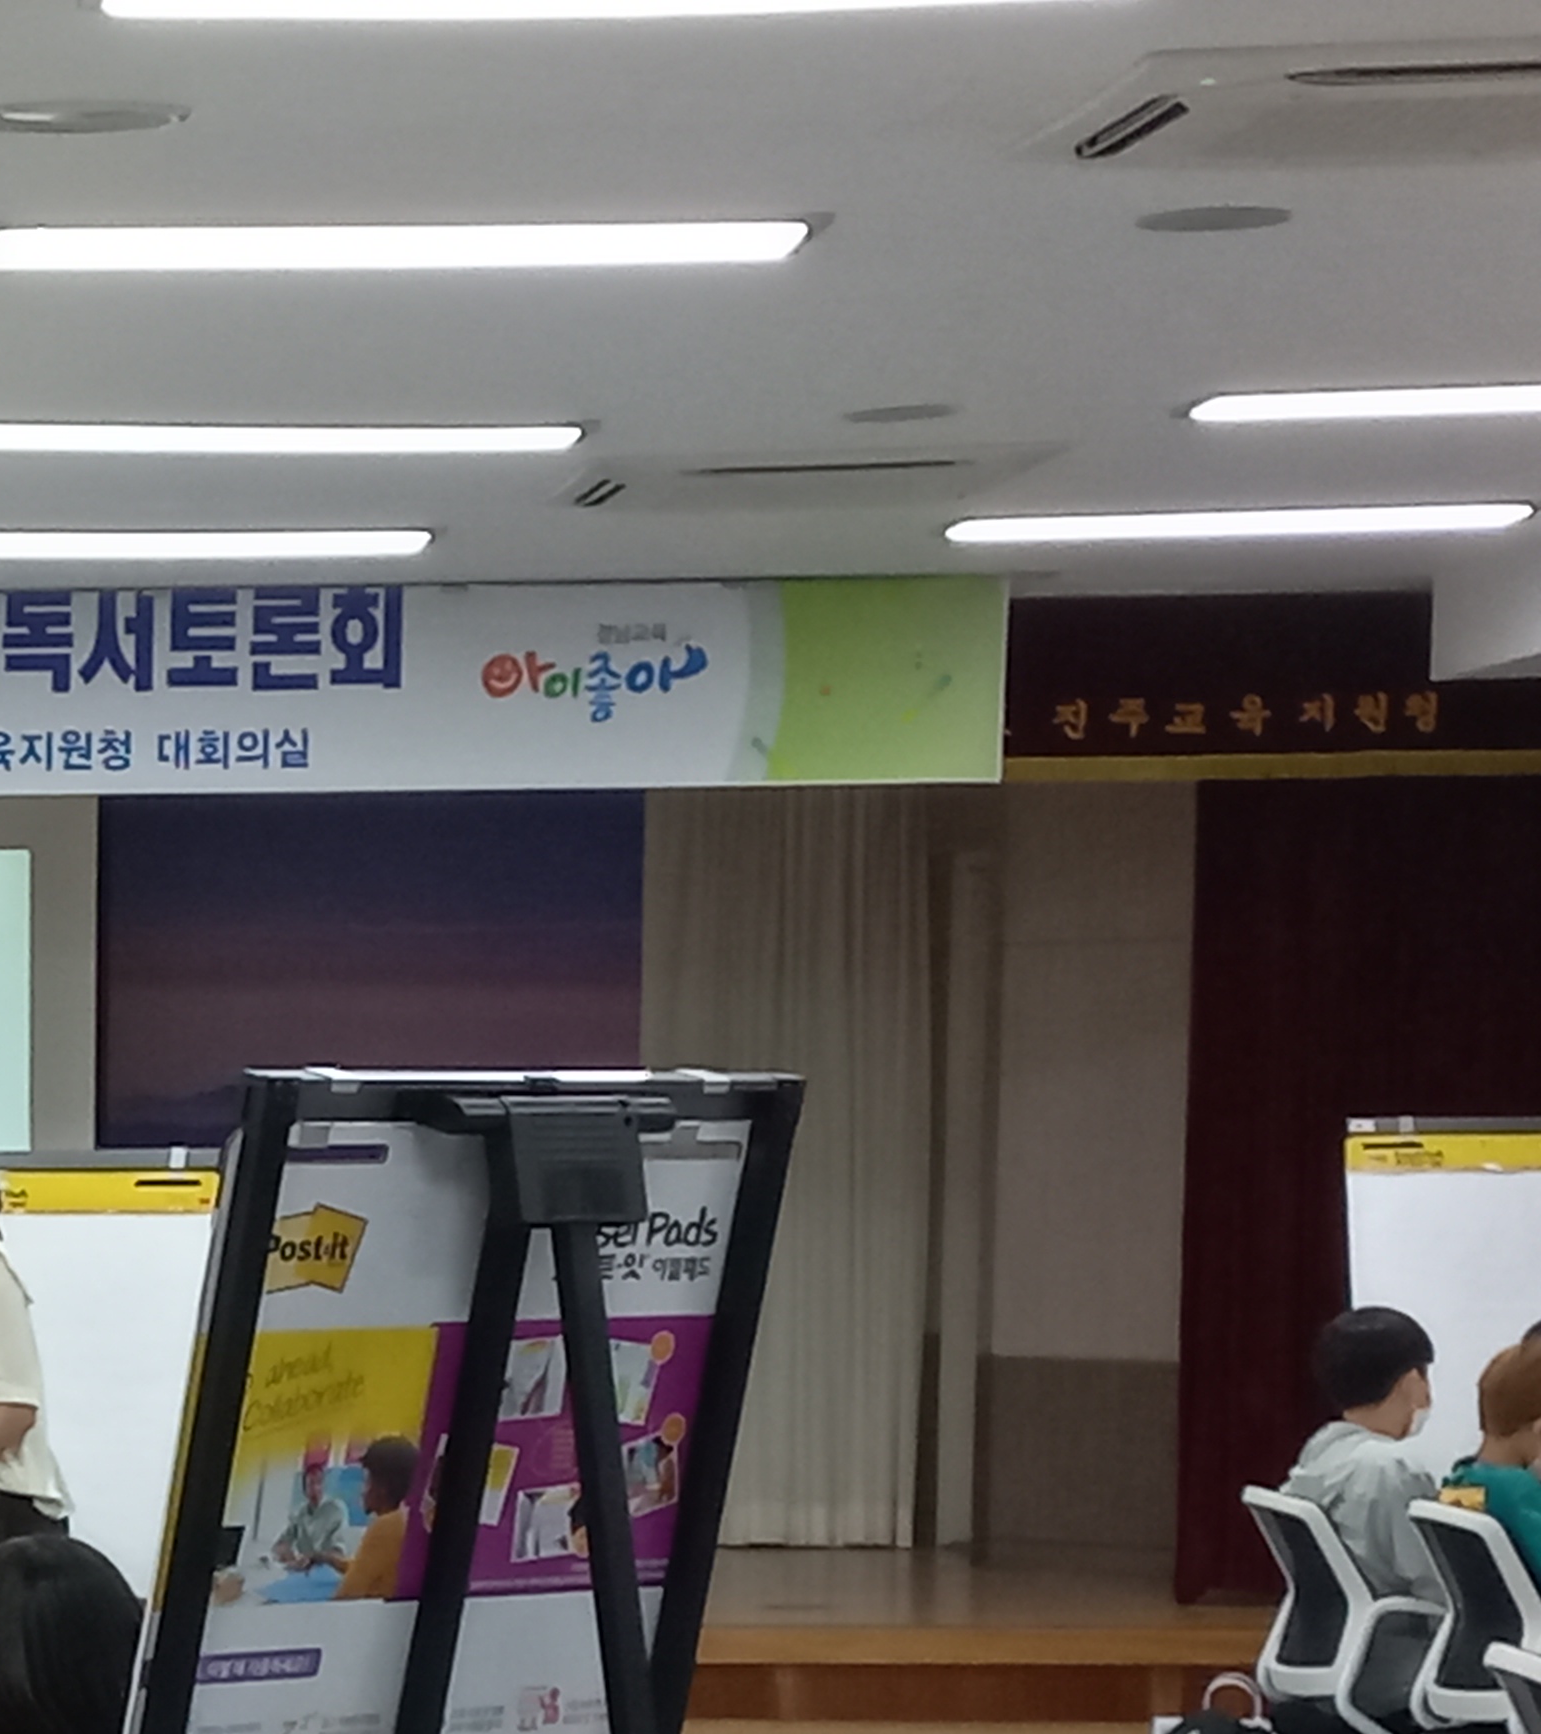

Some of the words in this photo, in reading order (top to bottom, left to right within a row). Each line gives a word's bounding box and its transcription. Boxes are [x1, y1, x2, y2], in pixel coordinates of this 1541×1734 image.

[481, 643, 709, 723] 아이좋아
[1052, 691, 1439, 740] 진주교육지원청
[155, 730, 312, 771] 대회의실
[646, 1205, 718, 1247] Pads
